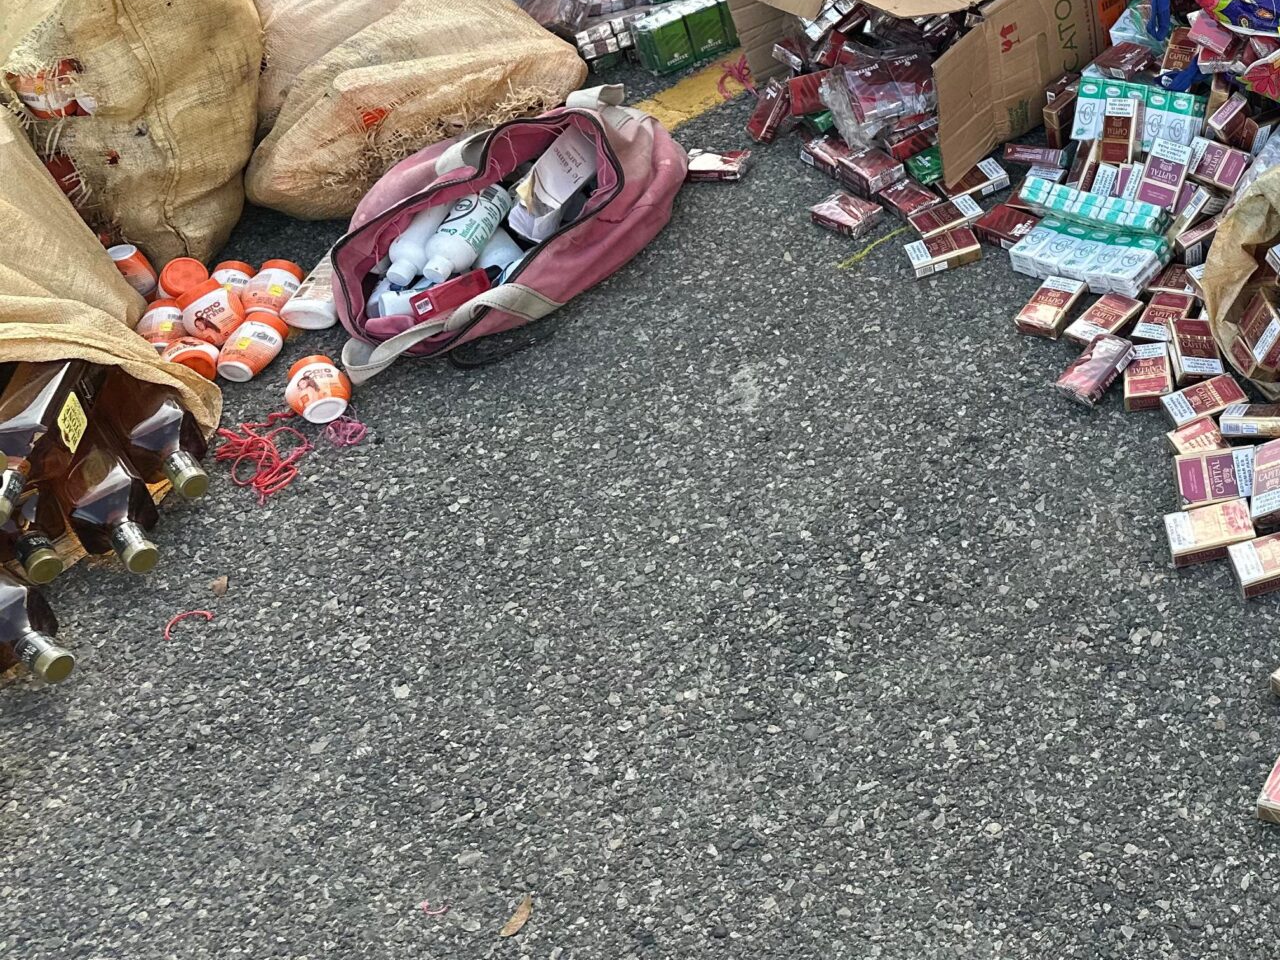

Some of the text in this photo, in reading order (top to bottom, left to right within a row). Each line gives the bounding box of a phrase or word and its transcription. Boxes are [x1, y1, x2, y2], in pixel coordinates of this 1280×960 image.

[1055, 0, 1079, 72] CATO
[1151, 167, 1177, 182] CAPITAL
[1212, 459, 1225, 494] CAPITAL
